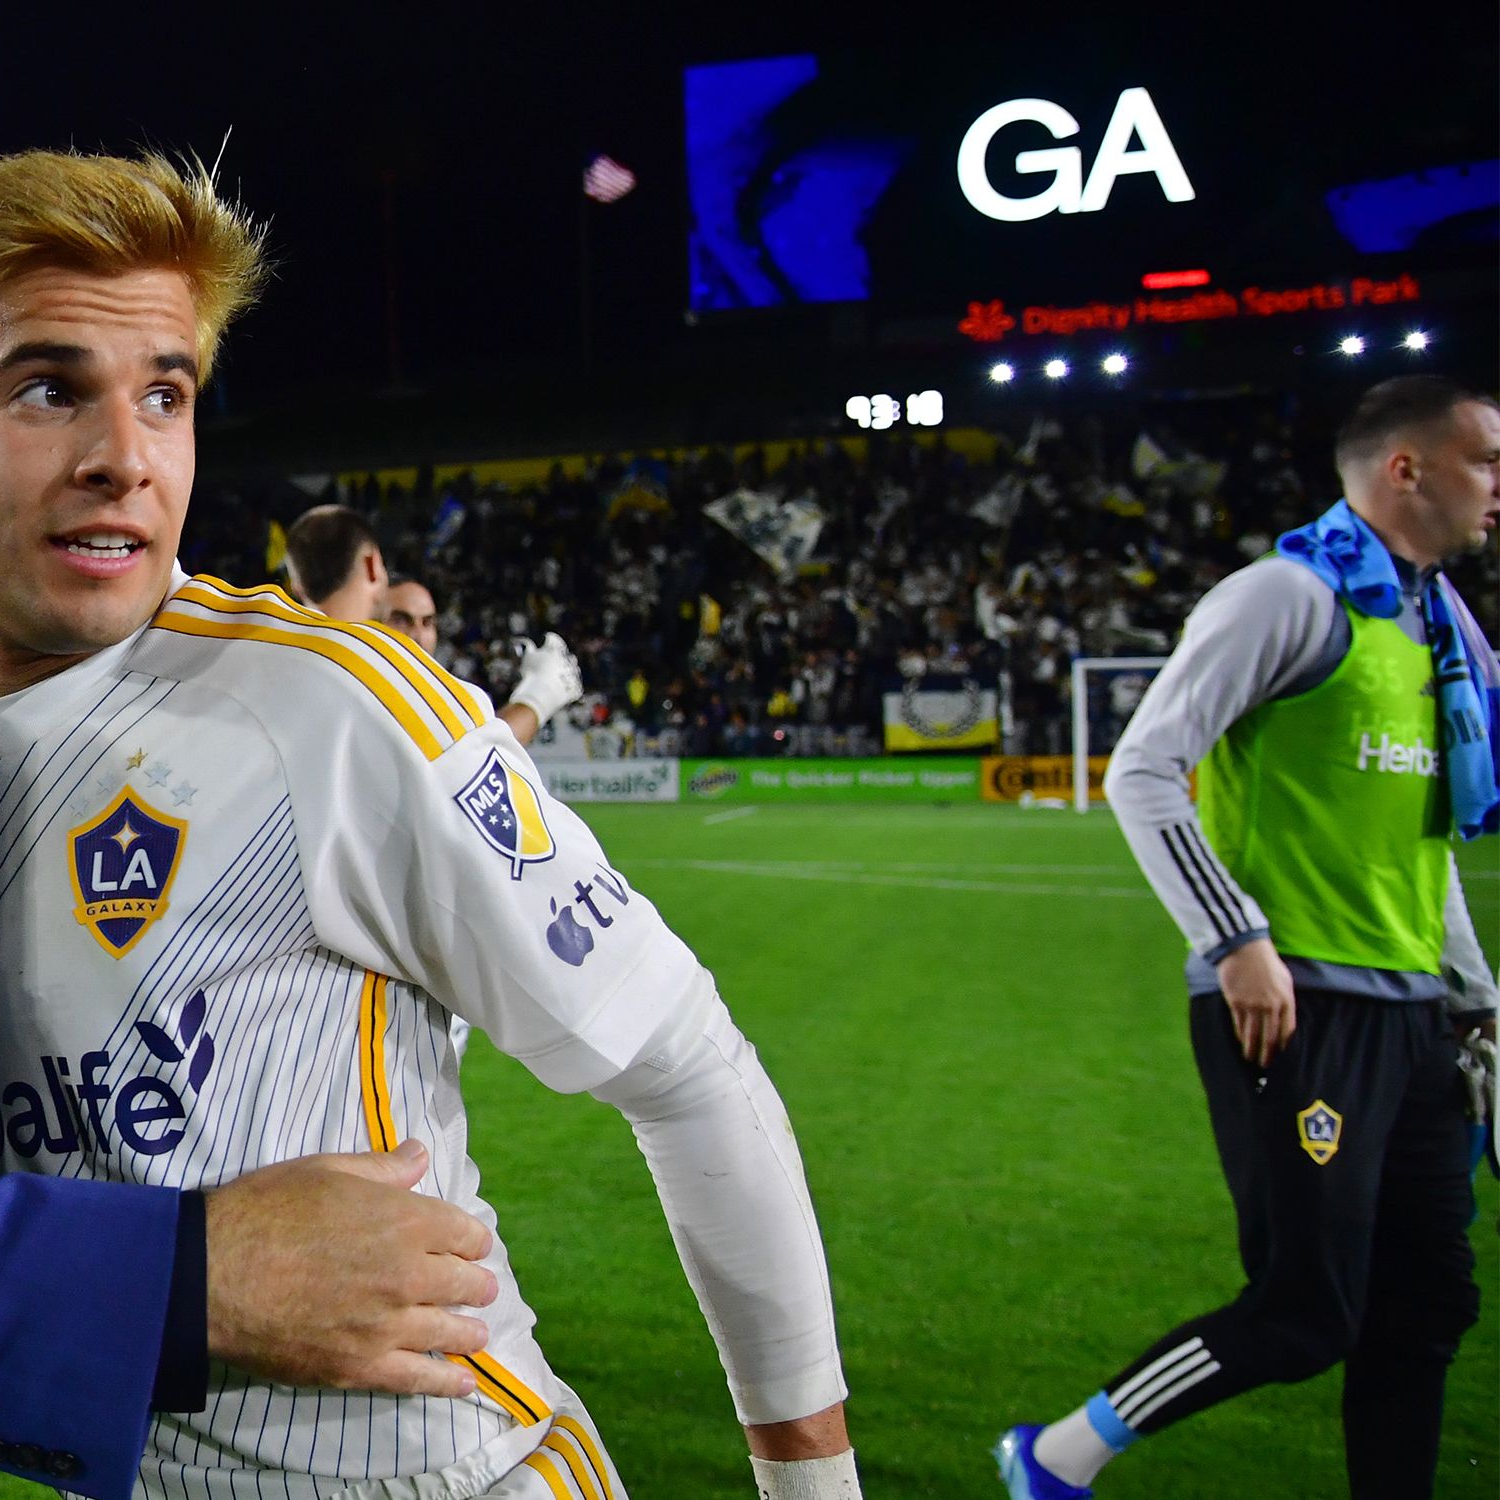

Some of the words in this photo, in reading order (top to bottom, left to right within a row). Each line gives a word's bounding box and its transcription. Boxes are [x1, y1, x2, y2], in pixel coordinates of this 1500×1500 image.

[957, 87, 1196, 221] GA
[1022, 304, 1130, 335] Dignity
[1134, 289, 1237, 323] Health
[1241, 286, 1344, 316] Sports
[1352, 273, 1419, 305] Park
[1357, 731, 1439, 777] Herb
[469, 773, 504, 817] MLS
[92, 848, 157, 892] LA
[86, 902, 158, 916] GALAXY
[574, 862, 629, 928] tv
